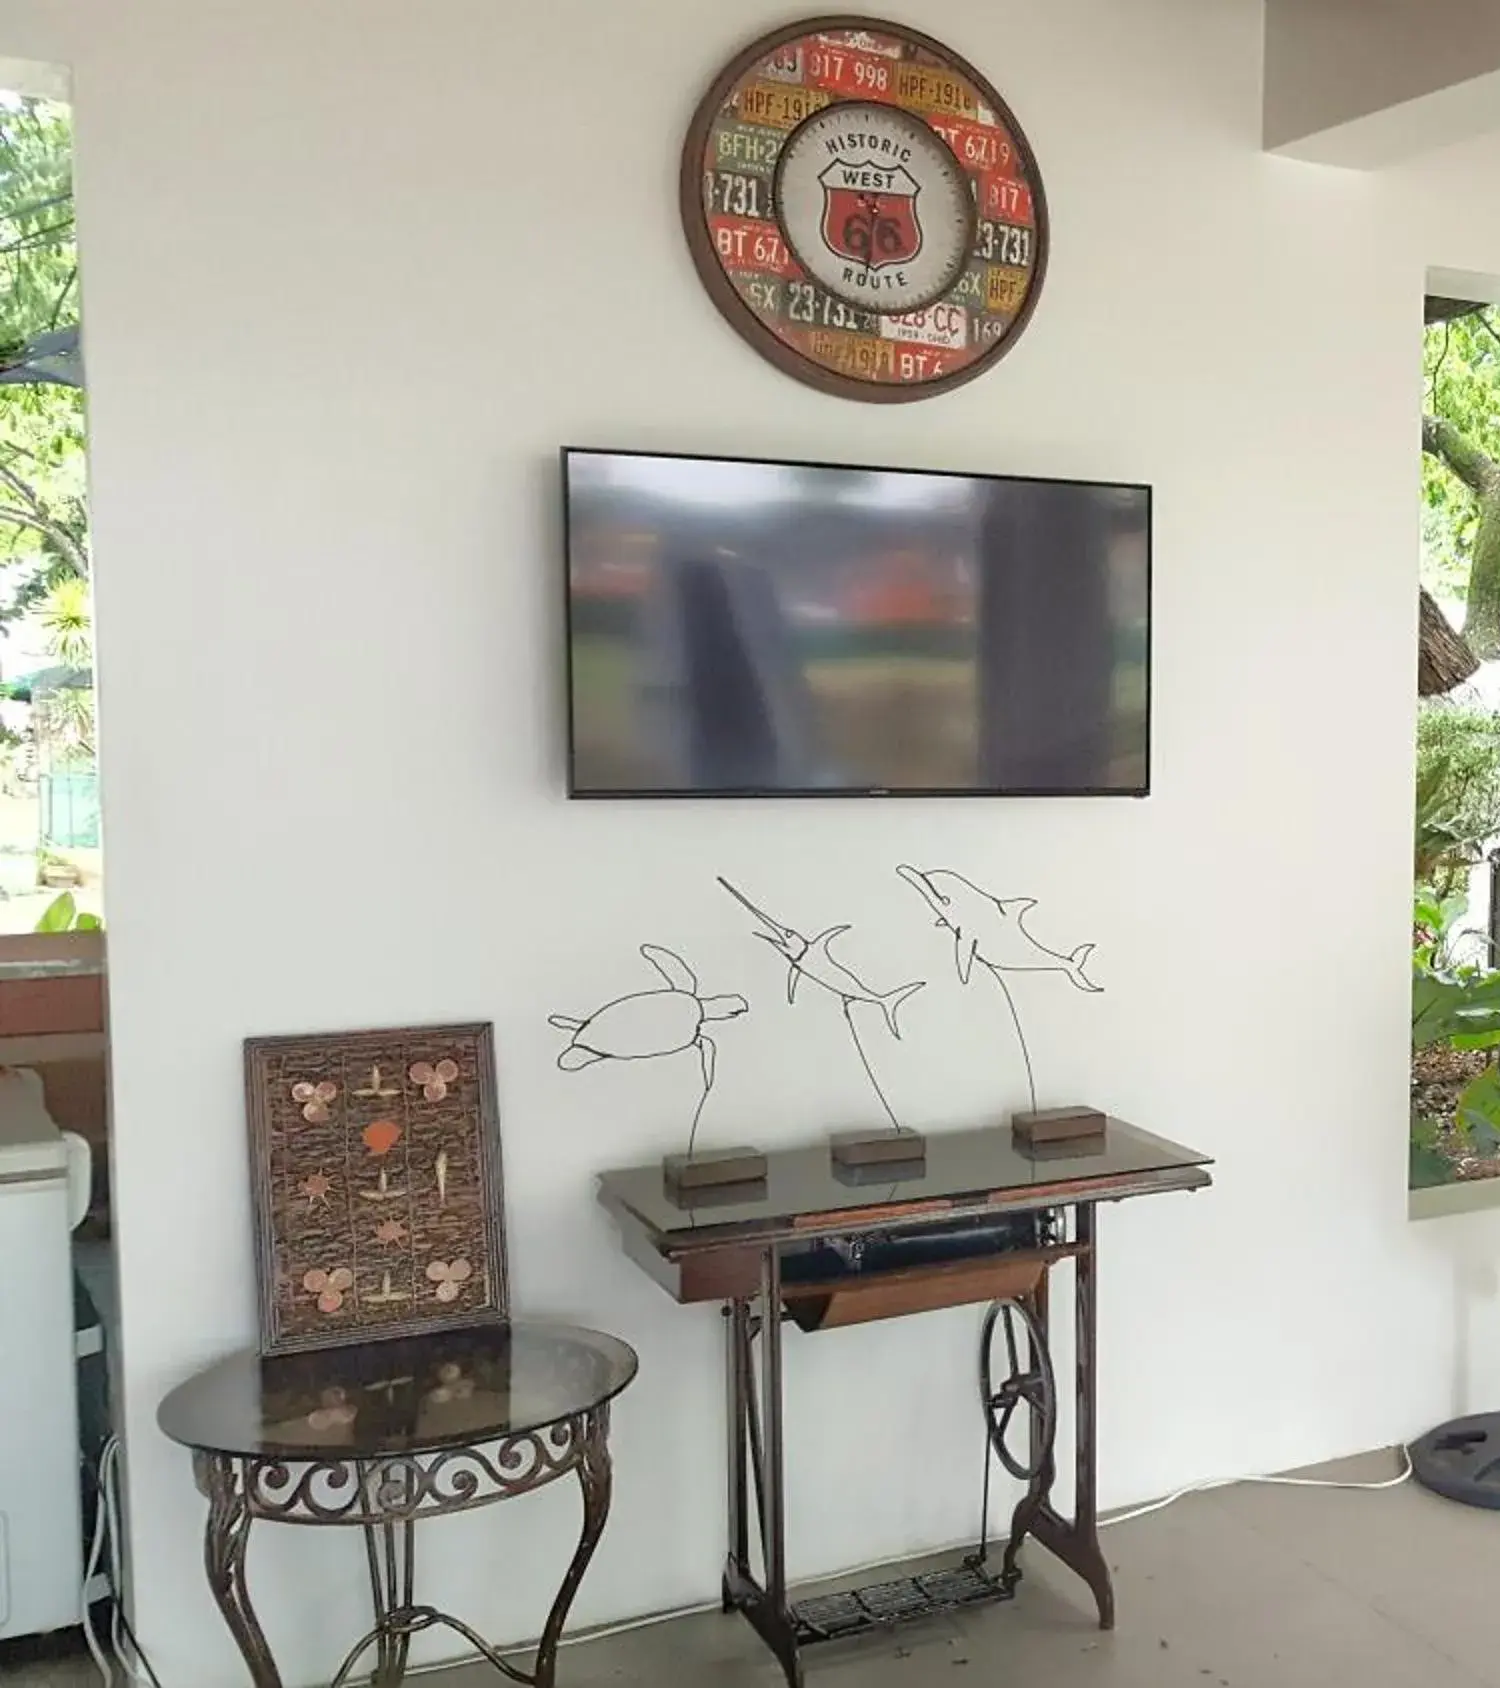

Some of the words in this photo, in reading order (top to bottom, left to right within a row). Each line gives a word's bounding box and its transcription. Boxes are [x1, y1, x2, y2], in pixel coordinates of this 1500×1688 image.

[854, 61, 888, 92] 998
[825, 133, 912, 163] HISTORIC
[842, 169, 896, 189] WEST
[716, 227, 748, 258] BT
[842, 213, 903, 258] 66
[841, 267, 910, 290] ROUTE
[901, 353, 928, 380] BT
